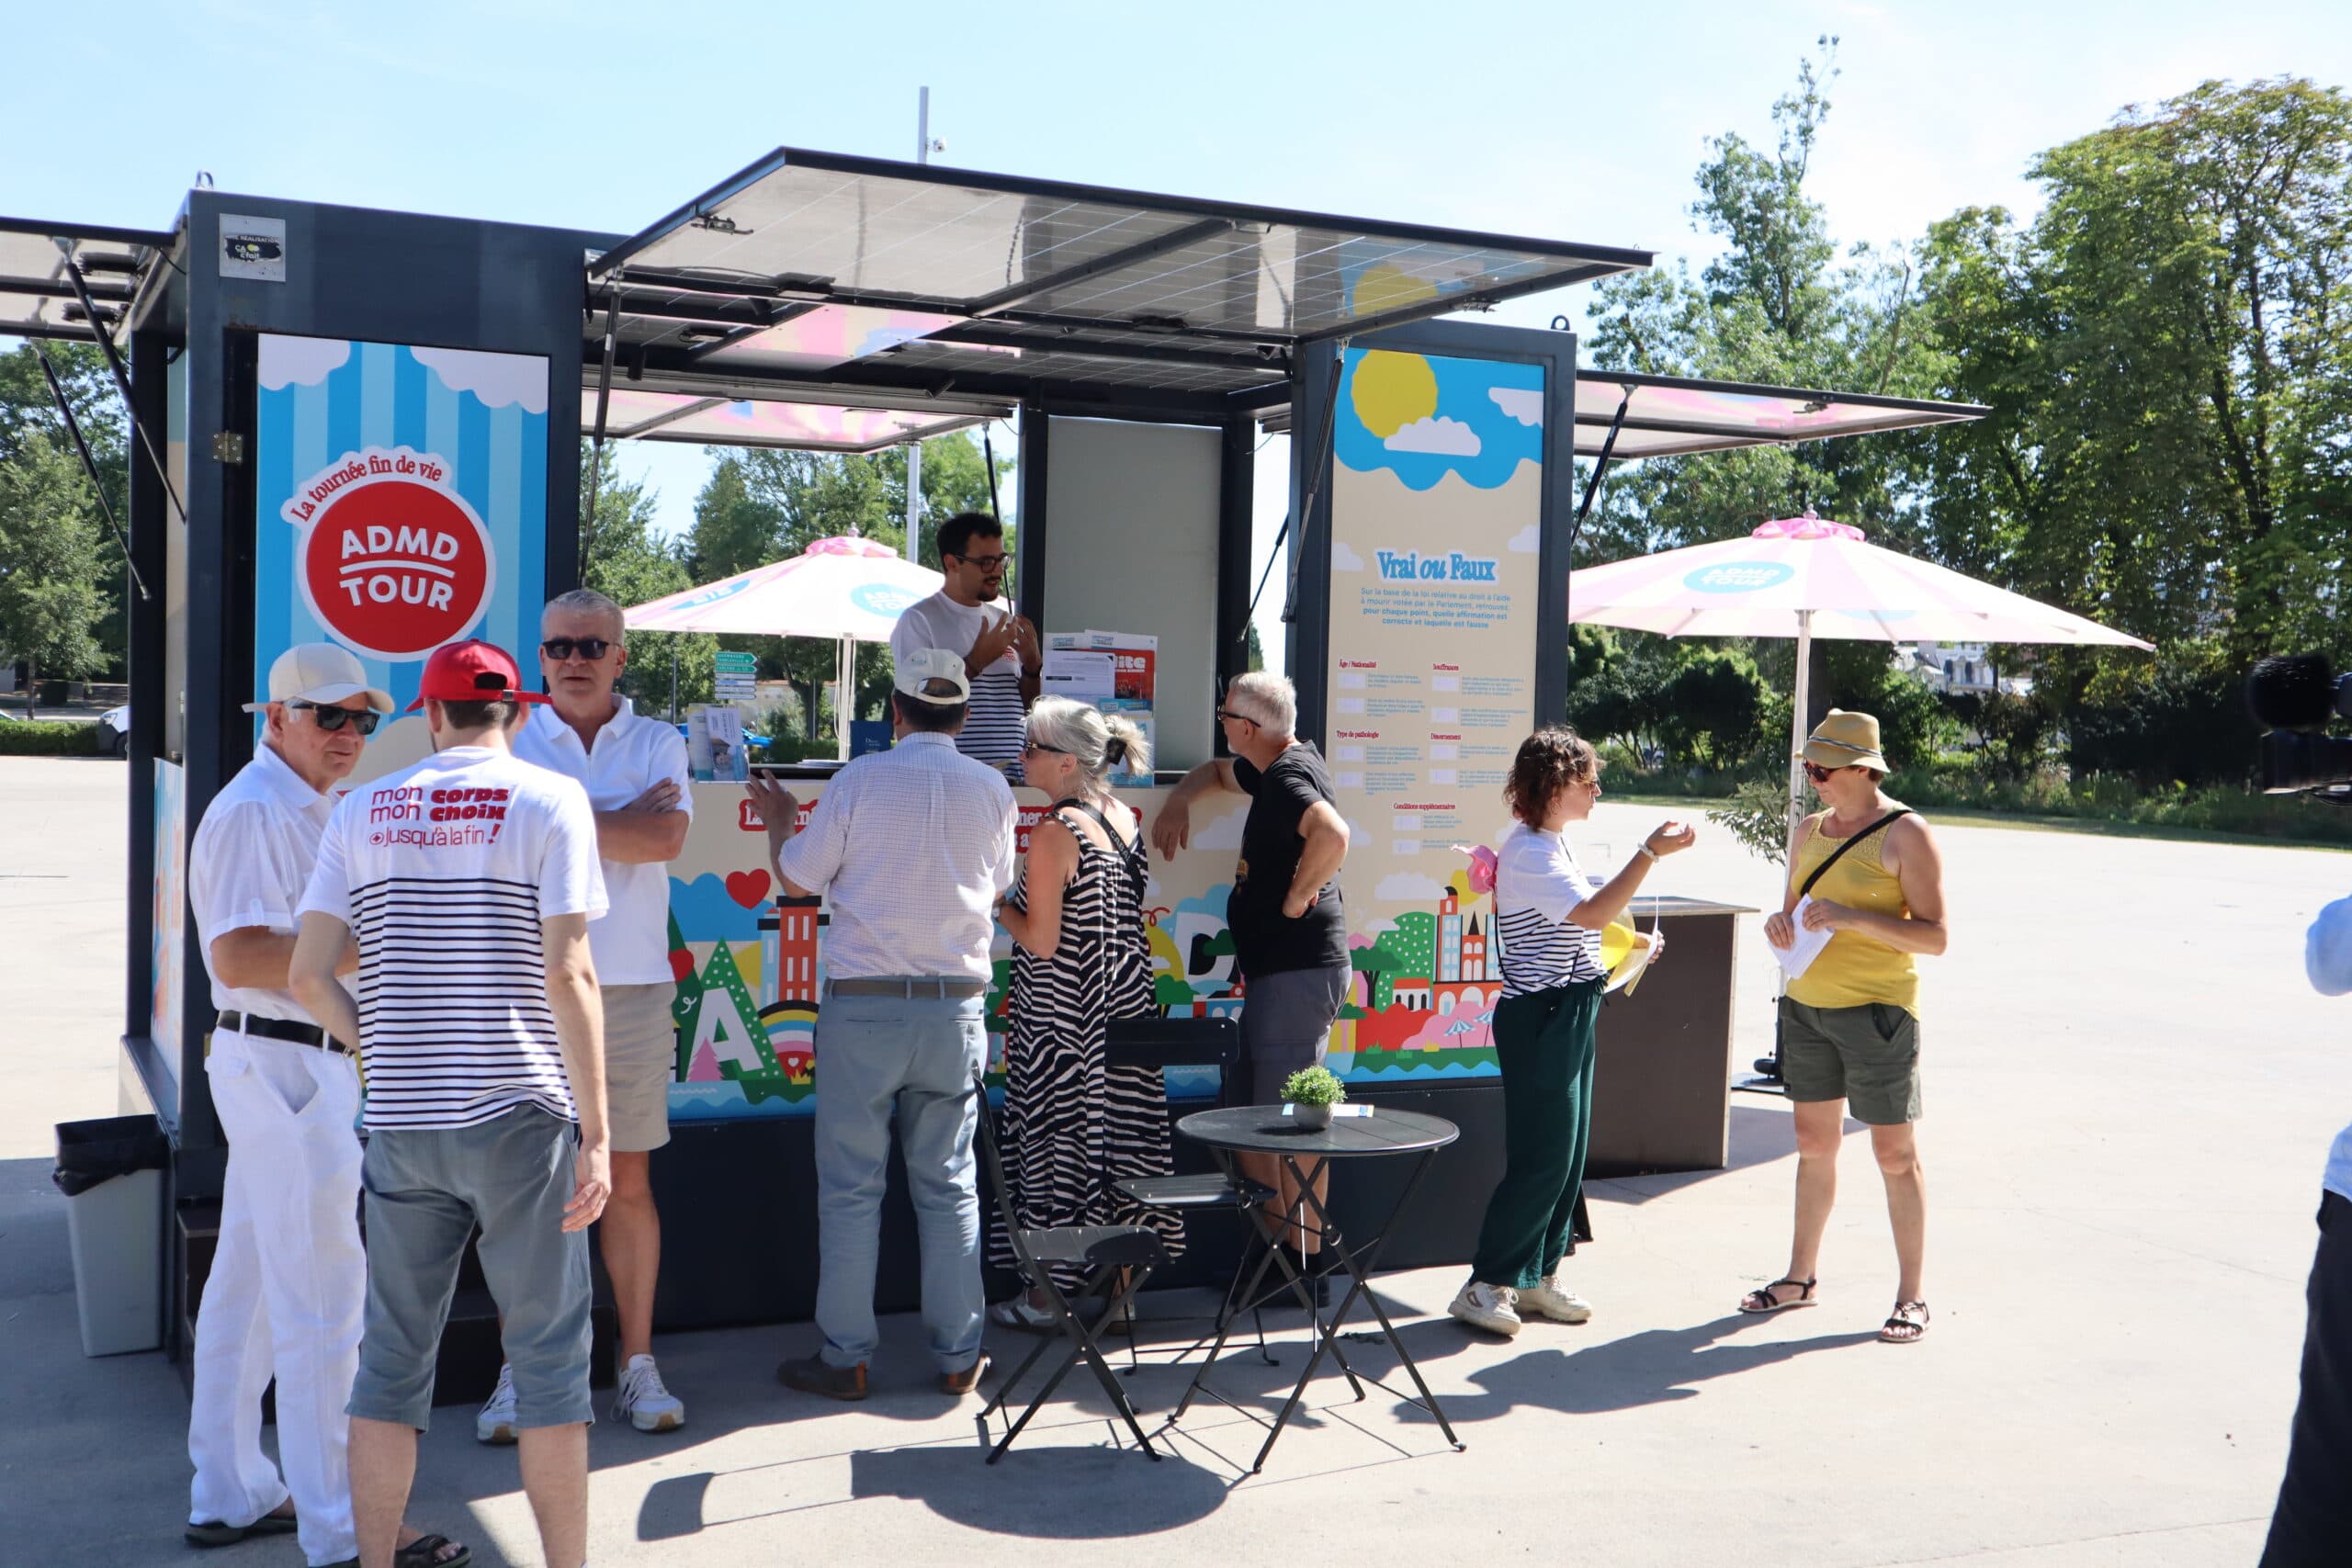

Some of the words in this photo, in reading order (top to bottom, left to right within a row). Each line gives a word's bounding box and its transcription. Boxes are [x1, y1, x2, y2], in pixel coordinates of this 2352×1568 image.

[290, 501, 316, 522] La
[308, 461, 368, 503] tournée
[368, 455, 392, 475] fin
[396, 455, 415, 474] de
[419, 460, 443, 482] vie
[341, 525, 459, 562] ADMD
[1377, 551, 1418, 579] Vrai
[1419, 558, 1447, 580] ou
[1450, 553, 1496, 581] Faux
[339, 574, 454, 612] TOUR
[1361, 587, 1374, 595] Sur
[1401, 589, 1411, 597] de
[1363, 608, 1380, 616] pour
[1382, 607, 1408, 617] chaque
[1432, 610, 1454, 619] quelle
[1456, 610, 1496, 619] affirmation
[1393, 598, 1413, 606] votée
[1414, 600, 1426, 608] par
[1382, 616, 1413, 625] correcte
[1424, 618, 1452, 627] laquelle
[1466, 620, 1489, 628] fausse
[372, 786, 424, 806] mon
[431, 787, 509, 805] corps
[370, 804, 421, 824] mon
[429, 804, 507, 822] choix
